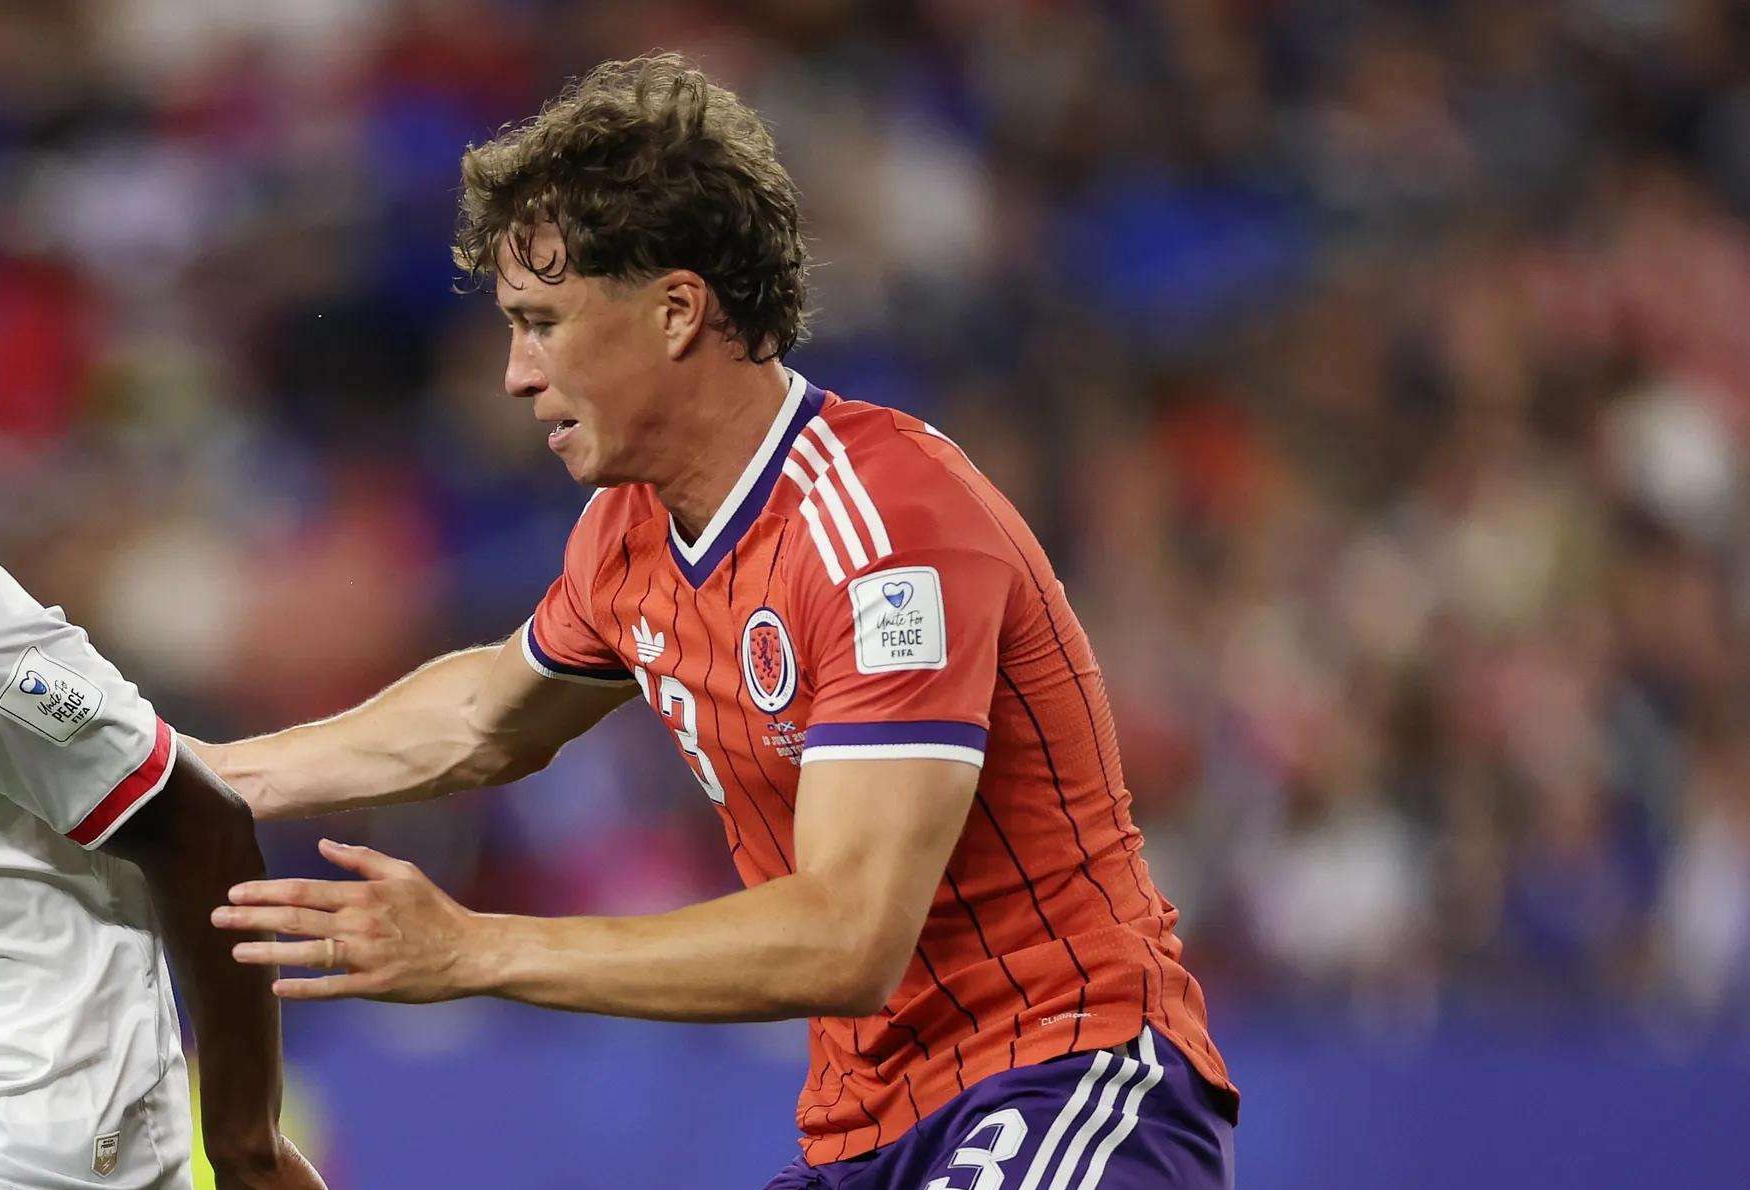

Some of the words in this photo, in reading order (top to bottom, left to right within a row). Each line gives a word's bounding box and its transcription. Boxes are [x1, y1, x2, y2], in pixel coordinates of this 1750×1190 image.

[881, 629, 923, 647] PEACE
[891, 649, 914, 658] FIFA
[52, 688, 85, 723] PEACE
[71, 707, 91, 724] FIFA
